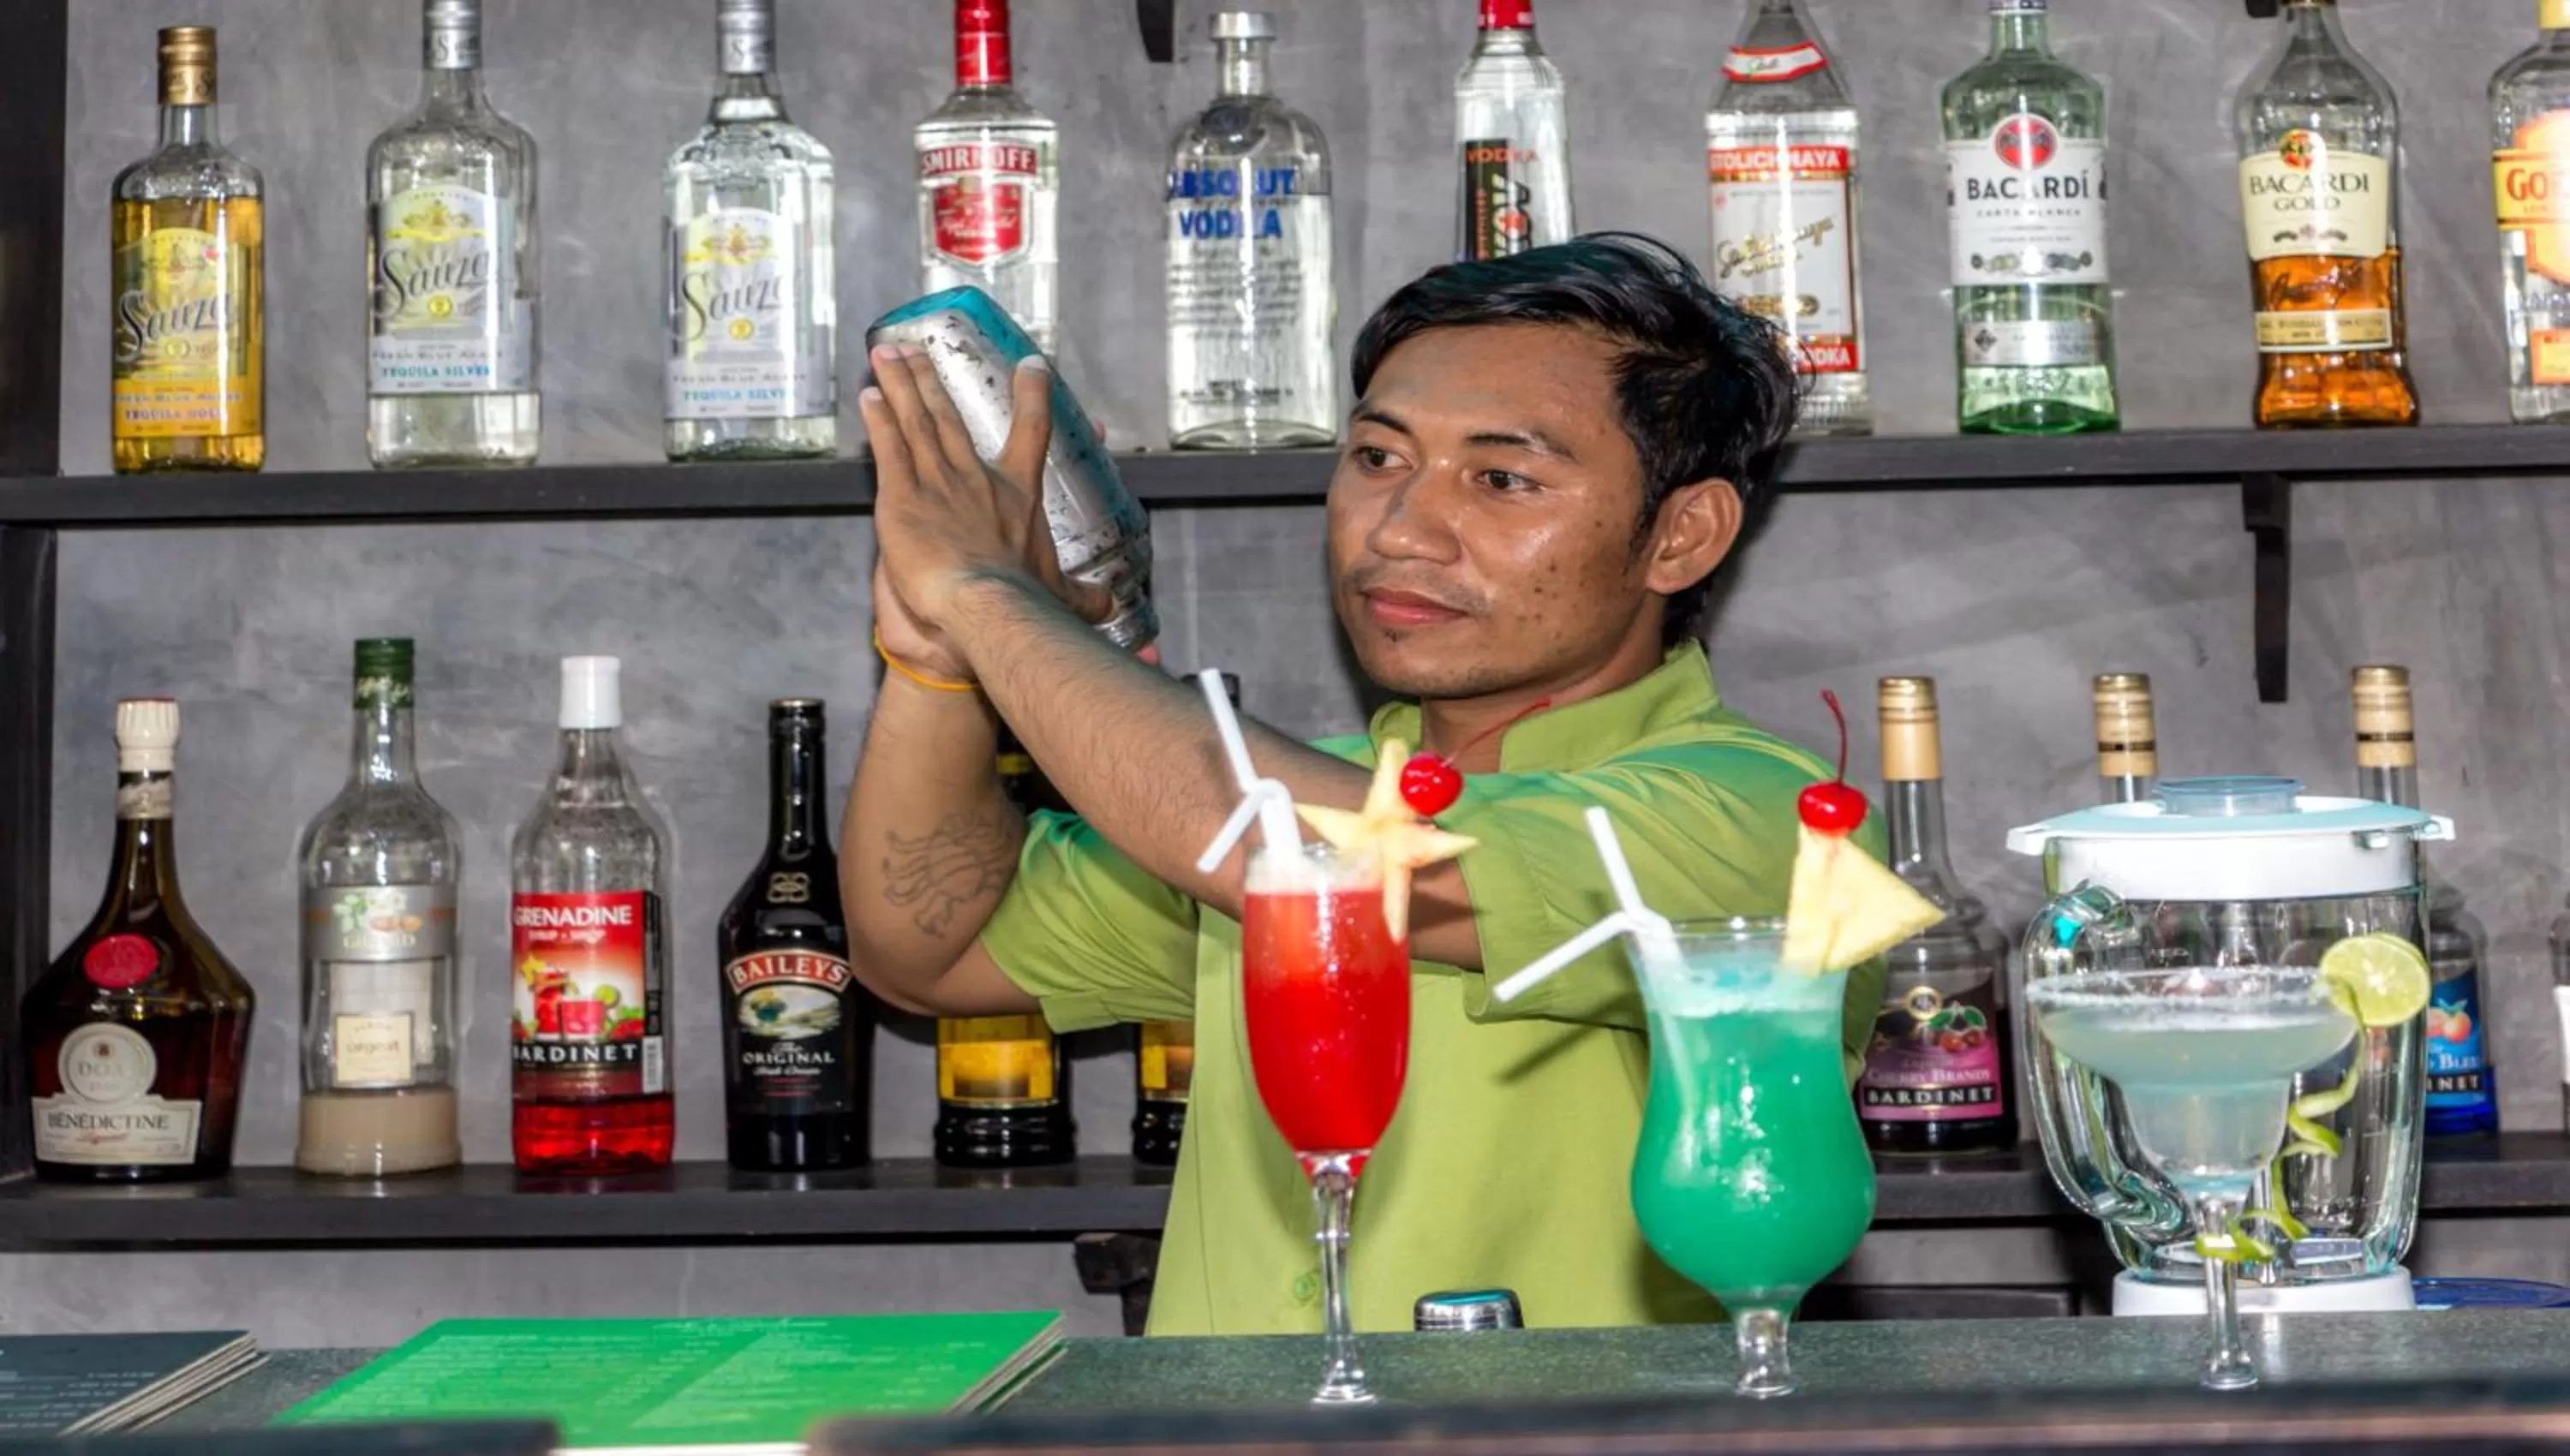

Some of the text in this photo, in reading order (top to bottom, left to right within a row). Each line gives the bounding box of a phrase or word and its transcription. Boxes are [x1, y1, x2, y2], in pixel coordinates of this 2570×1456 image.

[1173, 168, 1295, 198] ABSOUT
[1796, 346, 1851, 367] ODKA
[515, 905, 633, 928] GRENADINE
[733, 955, 850, 985] BAILEYS
[743, 1051, 836, 1065] ORIGINAL
[1868, 1087, 1993, 1104] BARDINET
